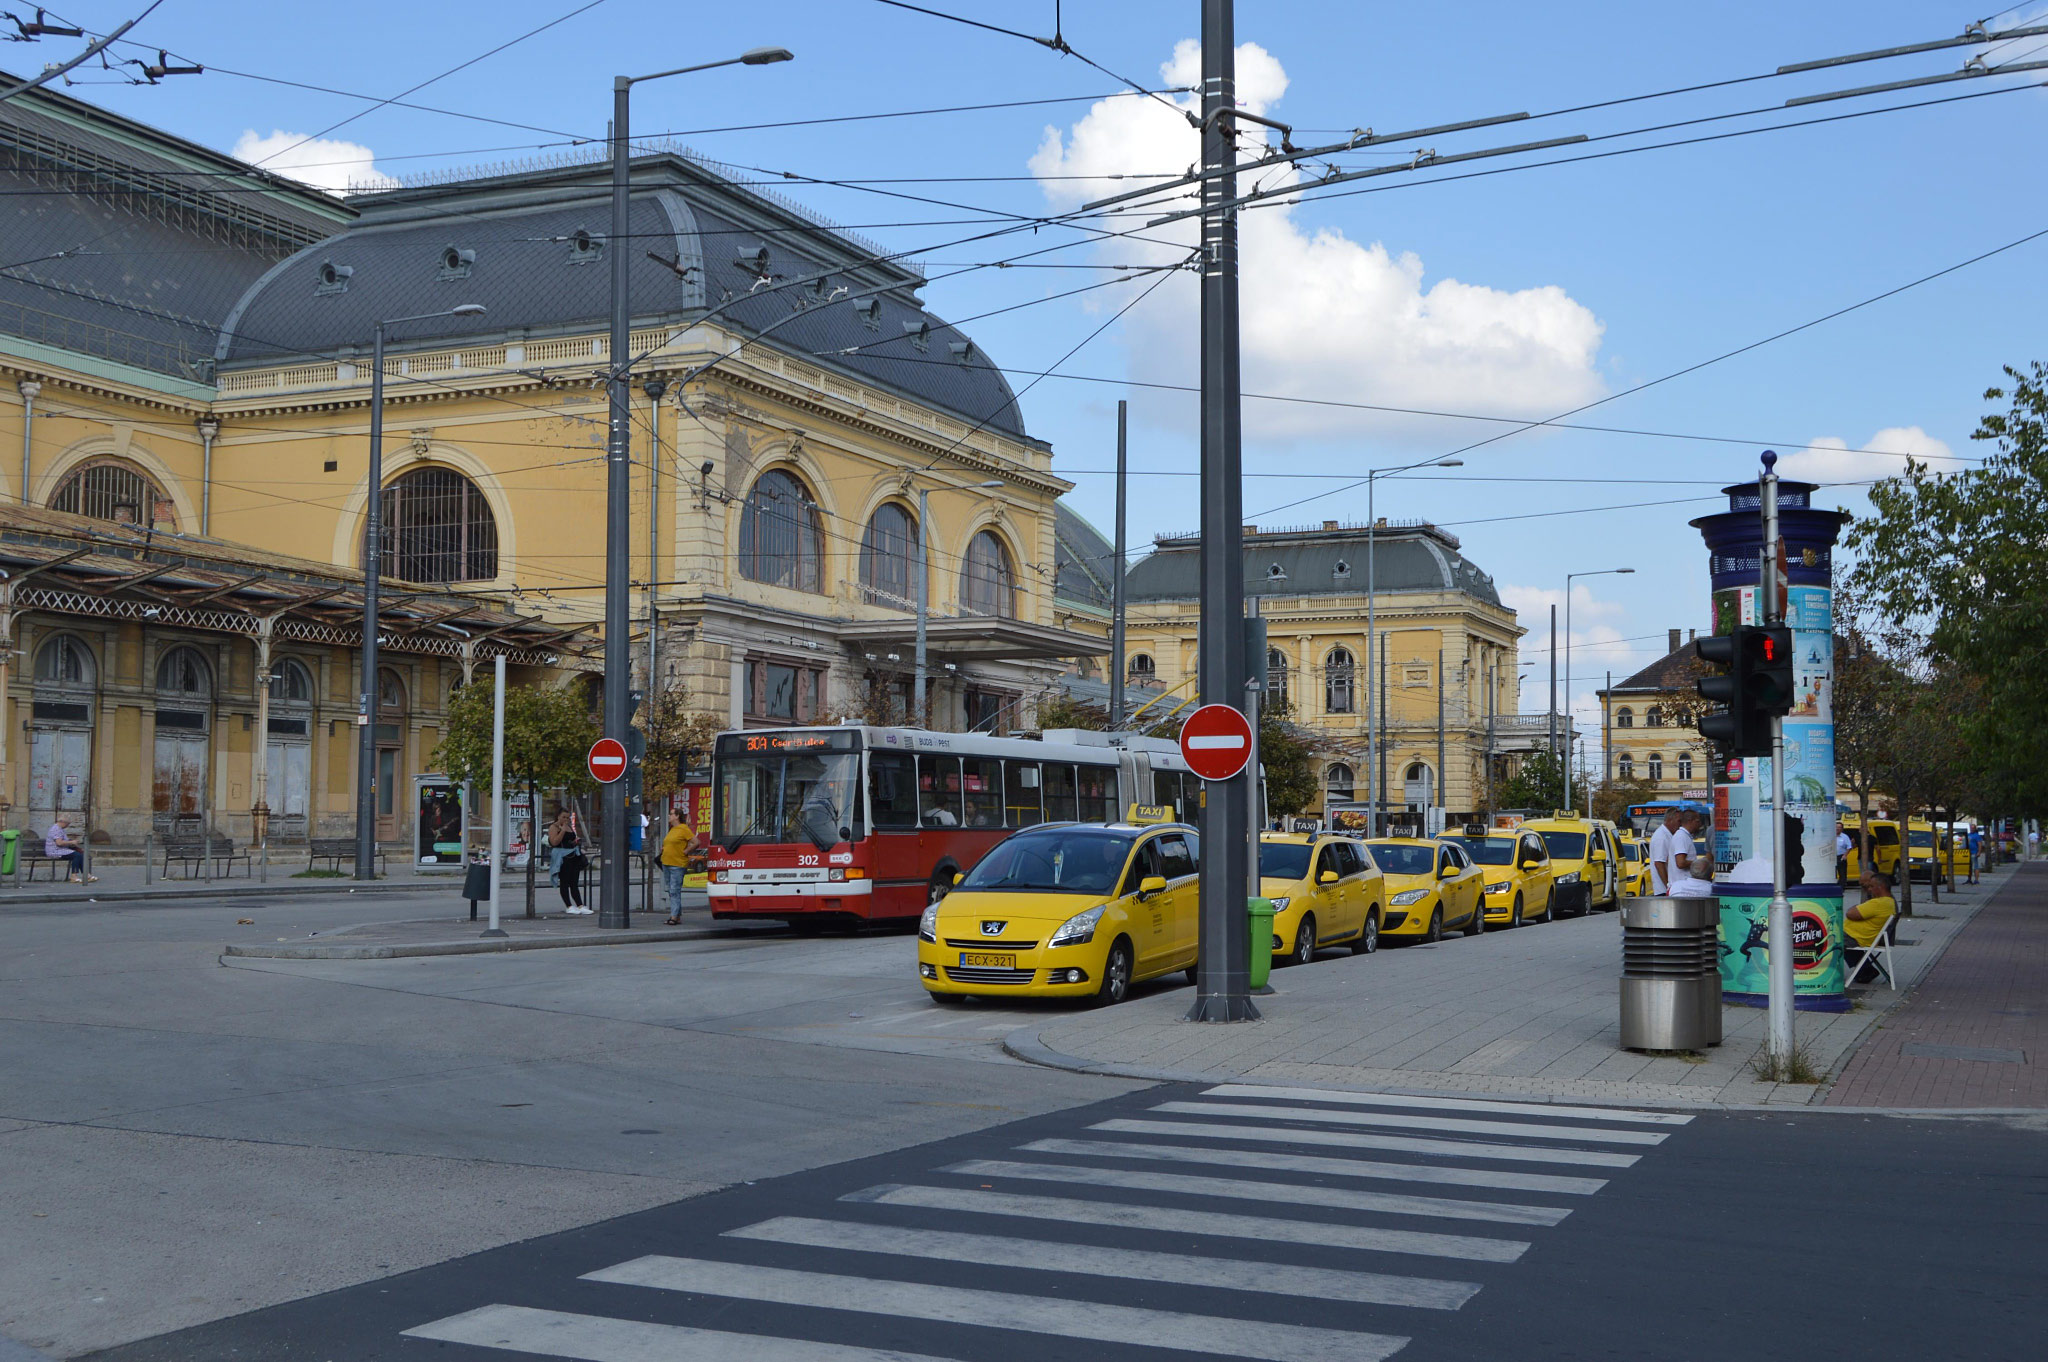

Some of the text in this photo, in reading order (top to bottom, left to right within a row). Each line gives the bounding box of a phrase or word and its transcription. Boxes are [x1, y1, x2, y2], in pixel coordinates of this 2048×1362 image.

[1139, 806, 1162, 816] TAXI
[1296, 822, 1316, 831] TAXI
[1467, 826, 1484, 834] TAXI
[798, 854, 819, 866] 302
[967, 955, 1012, 967] ECX-321
